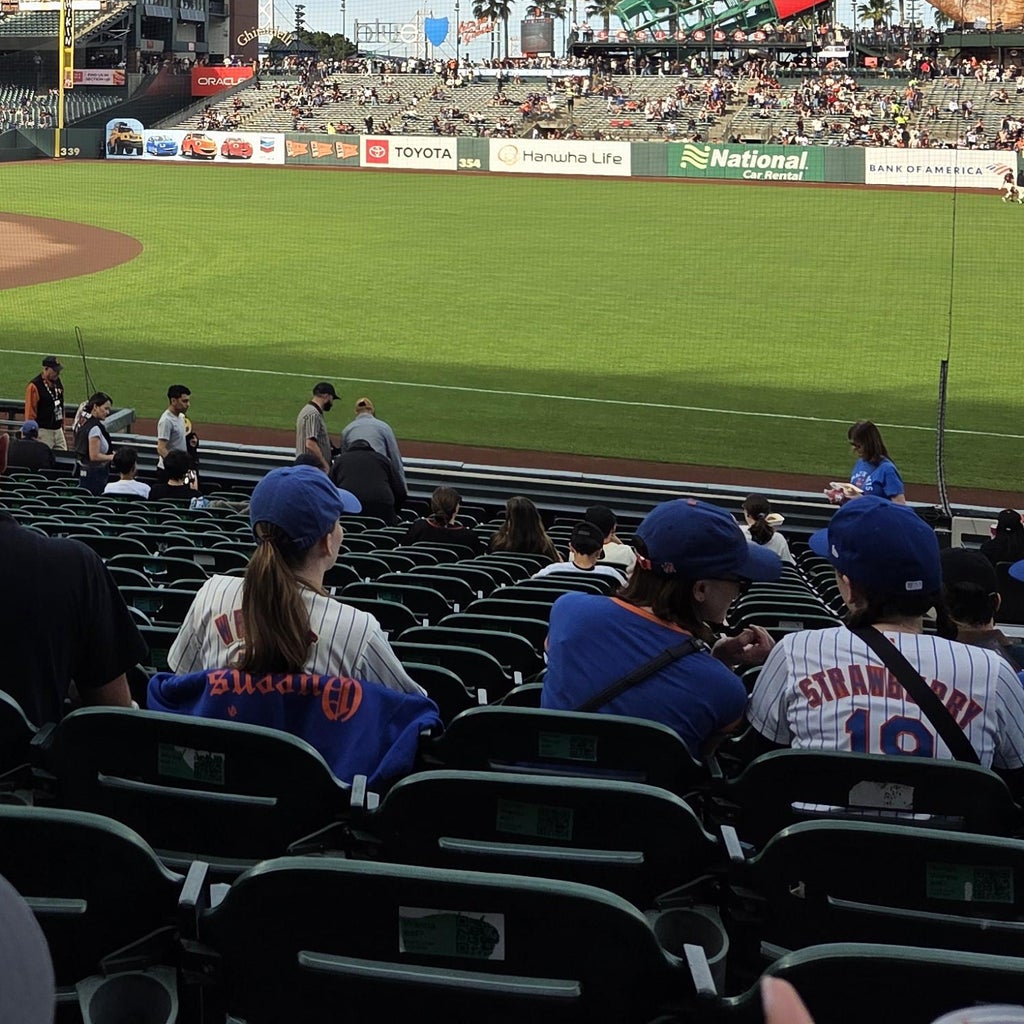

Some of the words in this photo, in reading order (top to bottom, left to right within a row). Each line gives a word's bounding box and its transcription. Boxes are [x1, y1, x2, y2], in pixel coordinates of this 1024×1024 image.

[354, 18, 419, 44] blue
[60, 147, 80, 156] 339
[394, 147, 452, 159] TOYOTA
[523, 150, 587, 163] Hanwha
[592, 152, 623, 164] Life
[458, 158, 481, 168] 354
[869, 164, 902, 173] BANK
[906, 165, 922, 173] OF
[925, 166, 983, 175] AMERICA
[742, 170, 763, 180] Car
[764, 171, 804, 181] Rental
